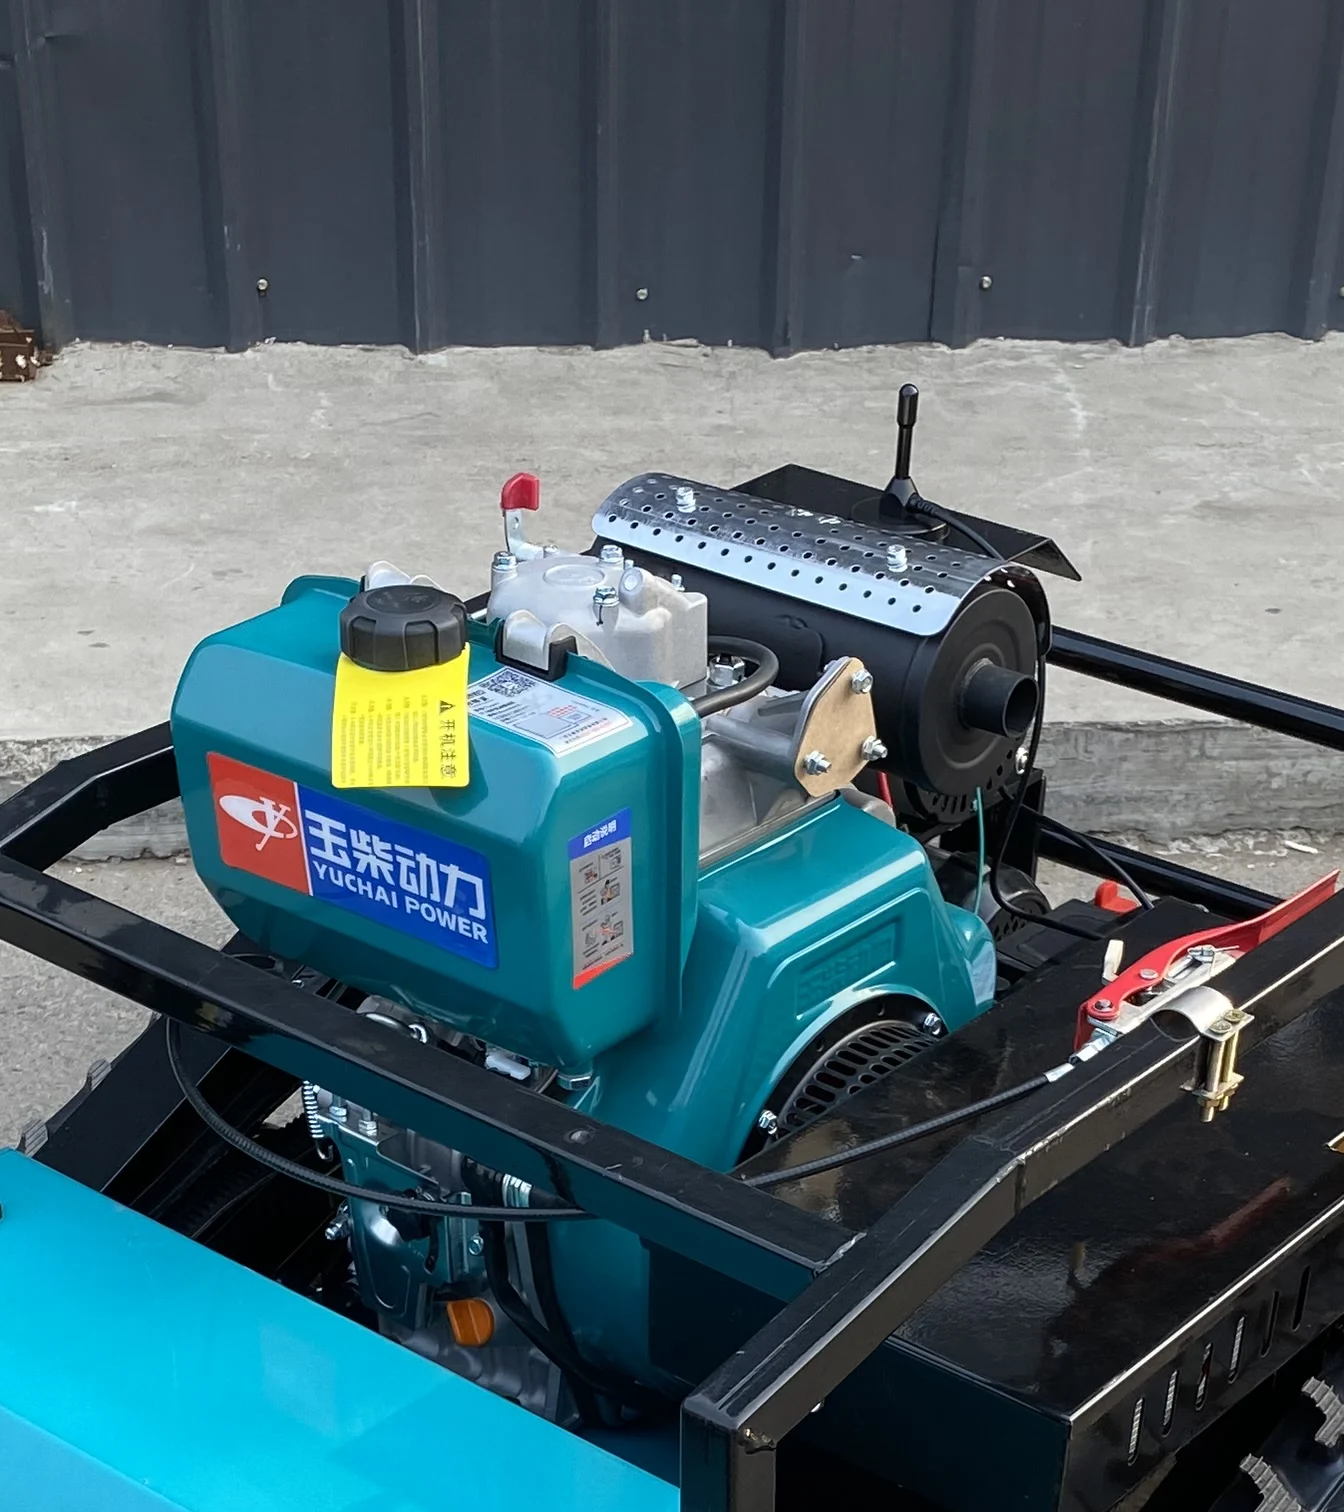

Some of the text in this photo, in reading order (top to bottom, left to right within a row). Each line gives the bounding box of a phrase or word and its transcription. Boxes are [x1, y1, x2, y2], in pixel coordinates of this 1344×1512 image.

[439, 719, 457, 779] 开机注意
[305, 808, 486, 922] 玉柴动力
[313, 860, 489, 944] YUCHAI POWER
